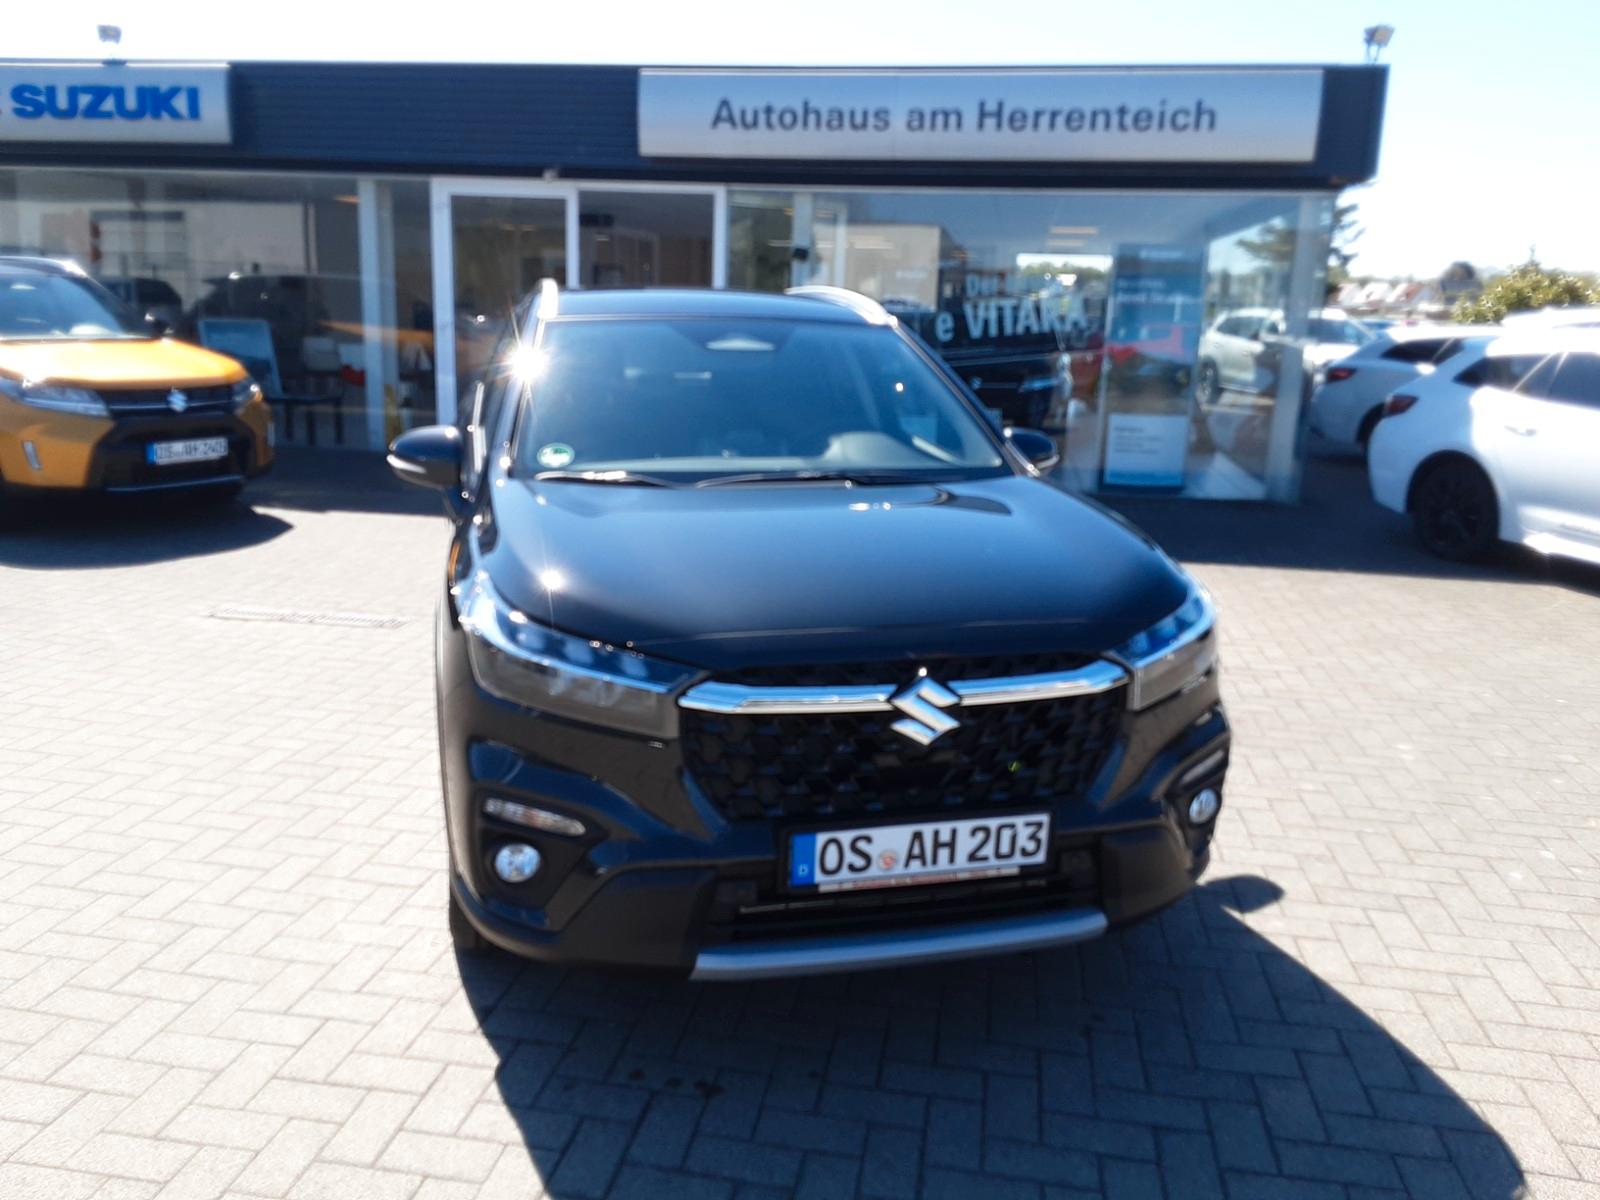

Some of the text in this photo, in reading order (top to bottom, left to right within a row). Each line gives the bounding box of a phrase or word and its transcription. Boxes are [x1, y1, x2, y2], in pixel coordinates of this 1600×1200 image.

[10, 83, 200, 121] SUZUKI
[710, 97, 1217, 133] Autohaus am Herrenteich
[963, 294, 1087, 340] VITARA
[818, 835, 873, 876] OS
[904, 827, 957, 868] AH
[967, 821, 1045, 863] 203
